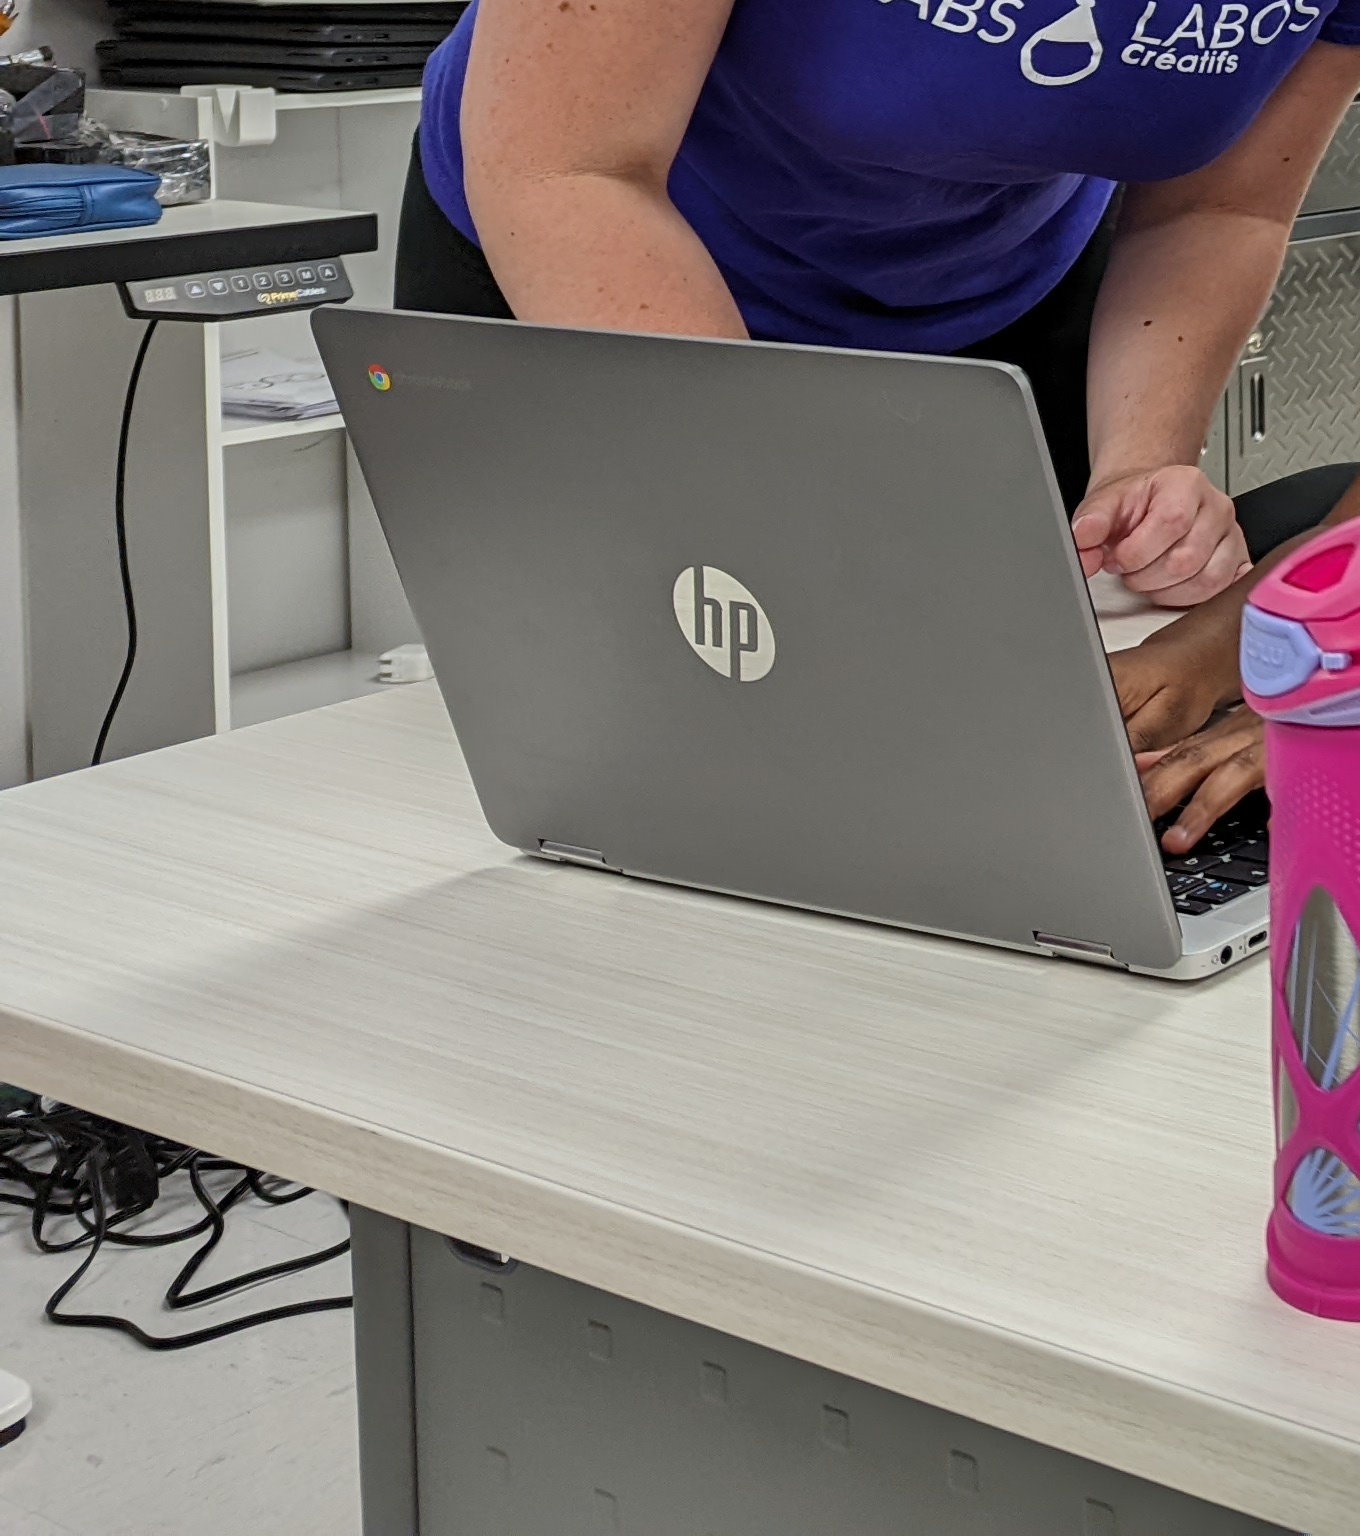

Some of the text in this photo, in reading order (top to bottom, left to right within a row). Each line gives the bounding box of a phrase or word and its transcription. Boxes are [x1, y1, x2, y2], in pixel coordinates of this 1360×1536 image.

[1120, 42, 1239, 75] Créatifs
[280, 273, 289, 283] 3
[301, 271, 311, 281] M
[323, 267, 333, 277] A
[694, 565, 758, 680] hp
